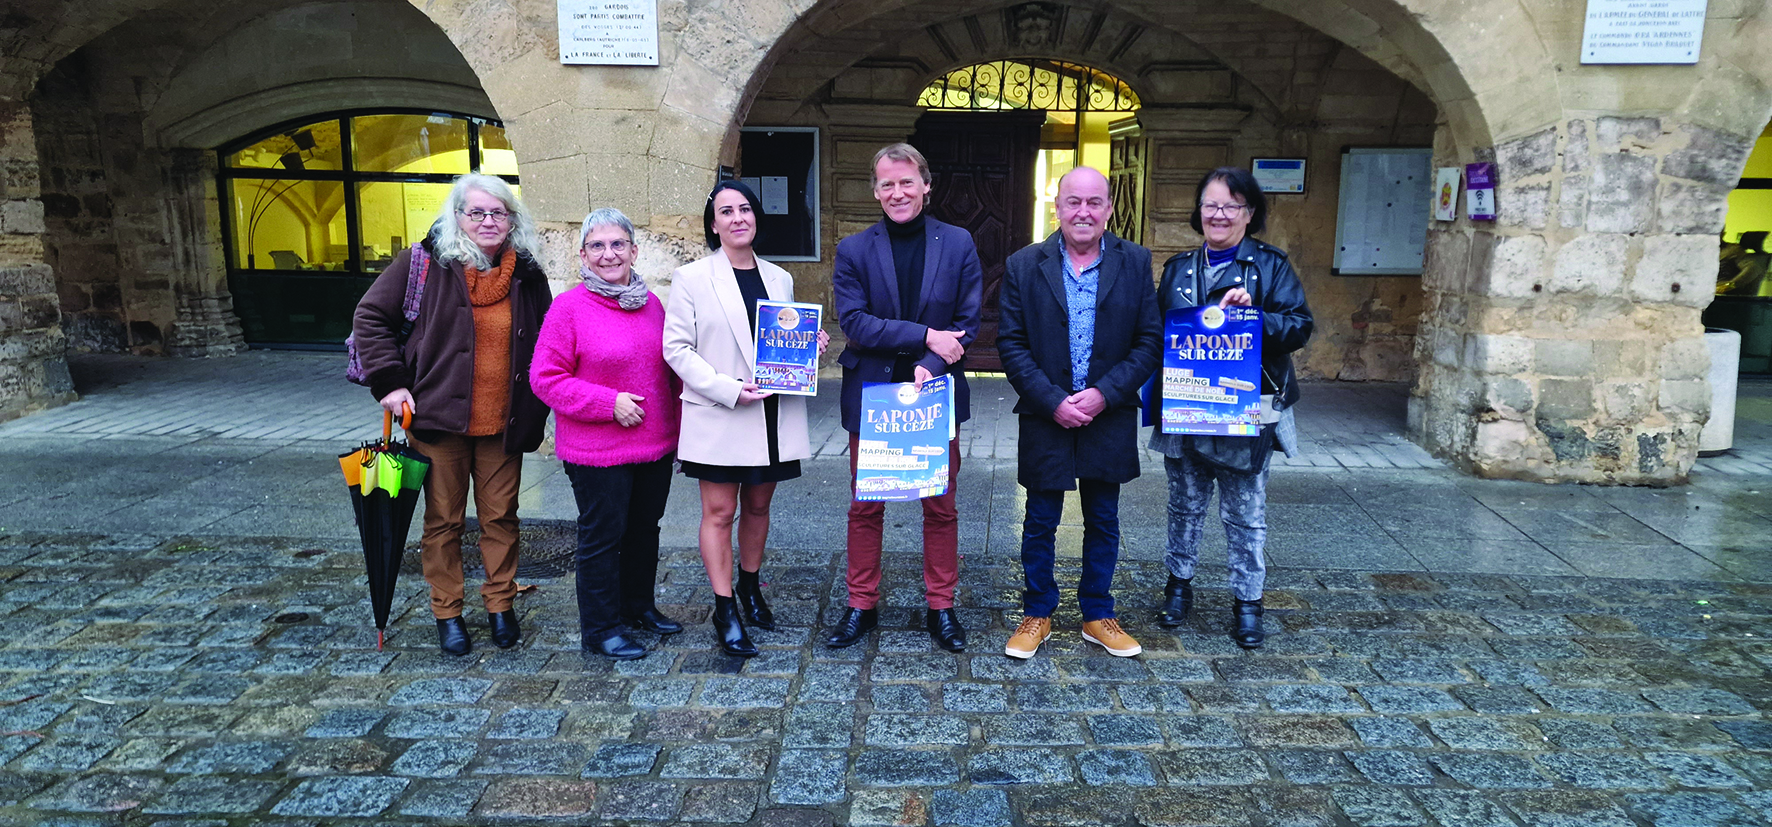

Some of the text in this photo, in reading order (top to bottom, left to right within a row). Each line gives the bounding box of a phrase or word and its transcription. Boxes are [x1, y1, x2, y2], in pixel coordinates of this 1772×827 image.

[760, 327, 815, 343] LAPONIE
[1170, 332, 1253, 350] LAPONIE
[766, 339, 808, 350] SUR CÈZE
[1179, 346, 1244, 360] SUR CÈZE
[1166, 368, 1190, 377] LUGE
[1165, 376, 1208, 386] MAPPING
[1206, 386, 1225, 394] NOËL
[867, 403, 942, 423] LAPONIE
[874, 418, 934, 433] SUR CÈZE
[860, 448, 901, 456] MAPPING
